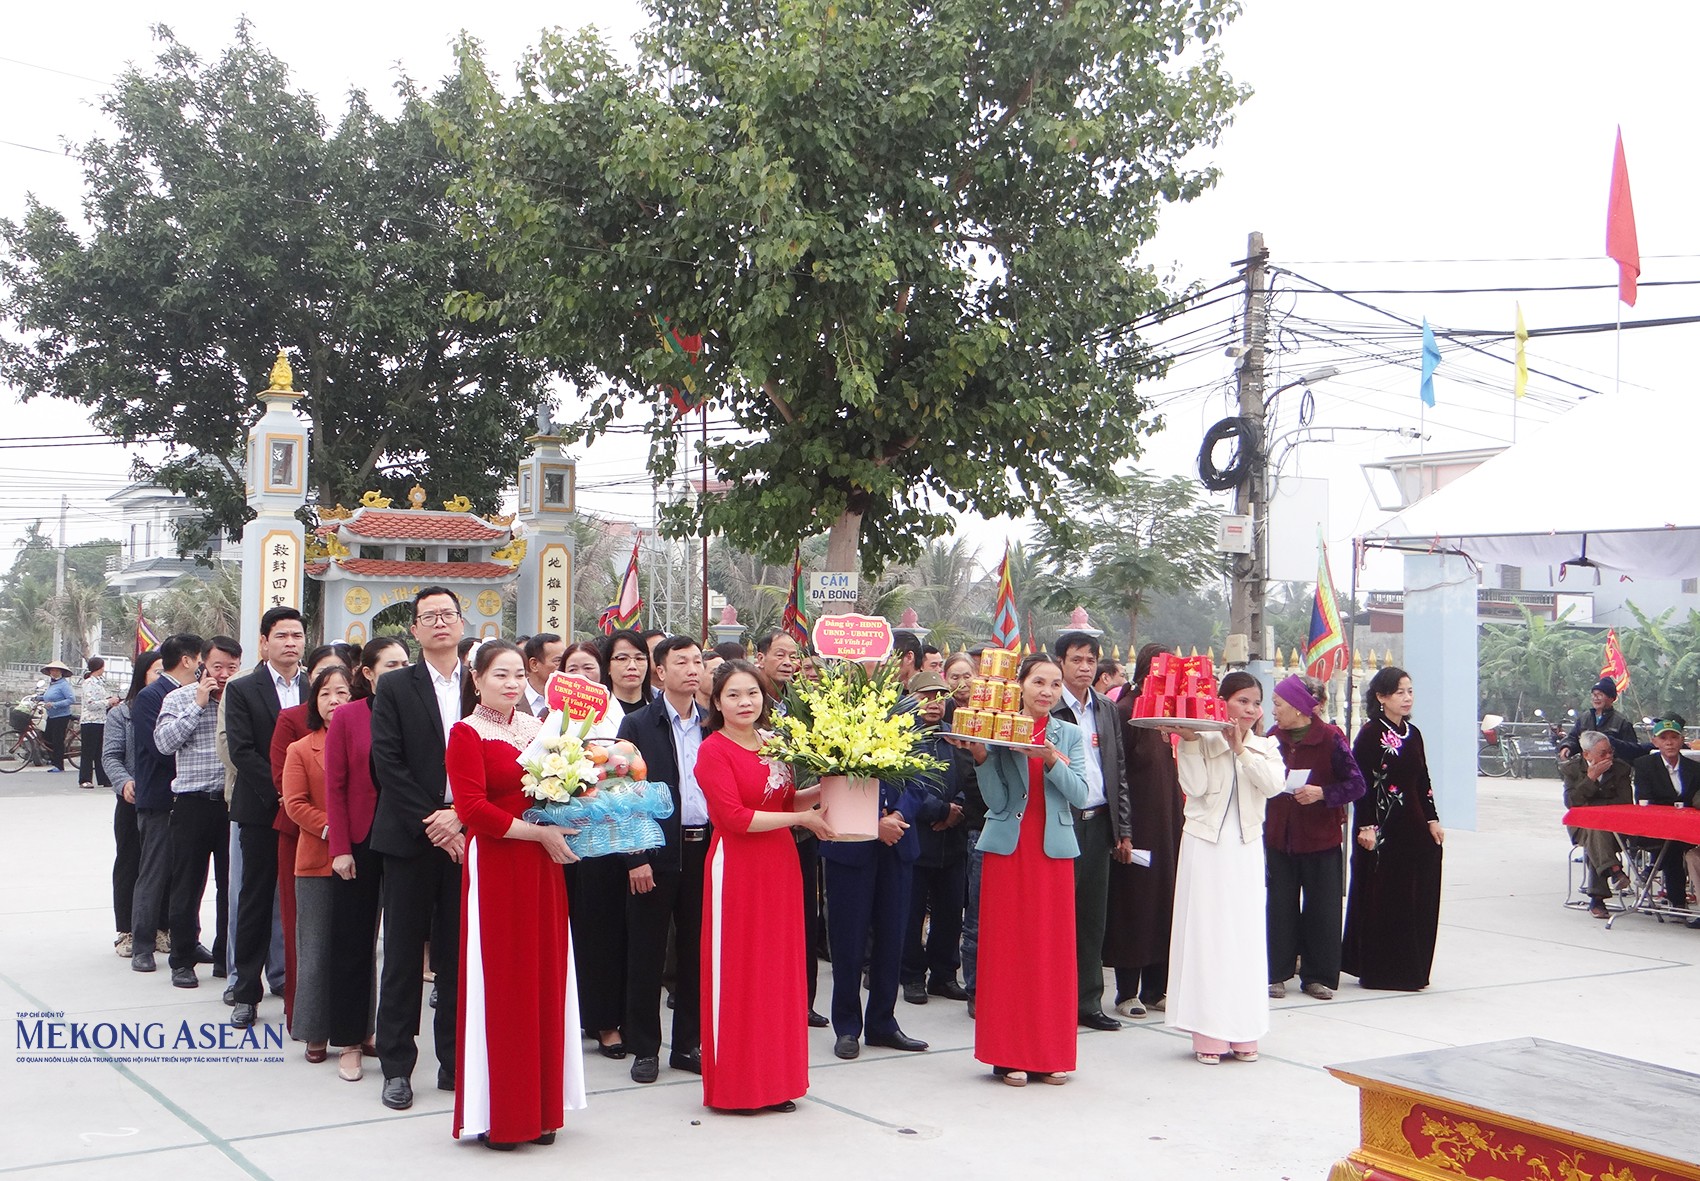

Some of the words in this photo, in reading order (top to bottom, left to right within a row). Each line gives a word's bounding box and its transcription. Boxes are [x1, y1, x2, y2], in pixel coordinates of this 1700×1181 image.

[820, 572, 849, 586] CẤM
[812, 587, 826, 599] ĐÁ
[828, 587, 857, 599] BÓNG
[825, 620, 844, 628] Đảng
[845, 620, 854, 628] ủy
[851, 630, 884, 639] UBMTTQ
[861, 639, 873, 647] Lại
[857, 647, 866, 655] Lễ
[554, 685, 573, 695] UBND
[576, 692, 604, 706] UBMTTQ
